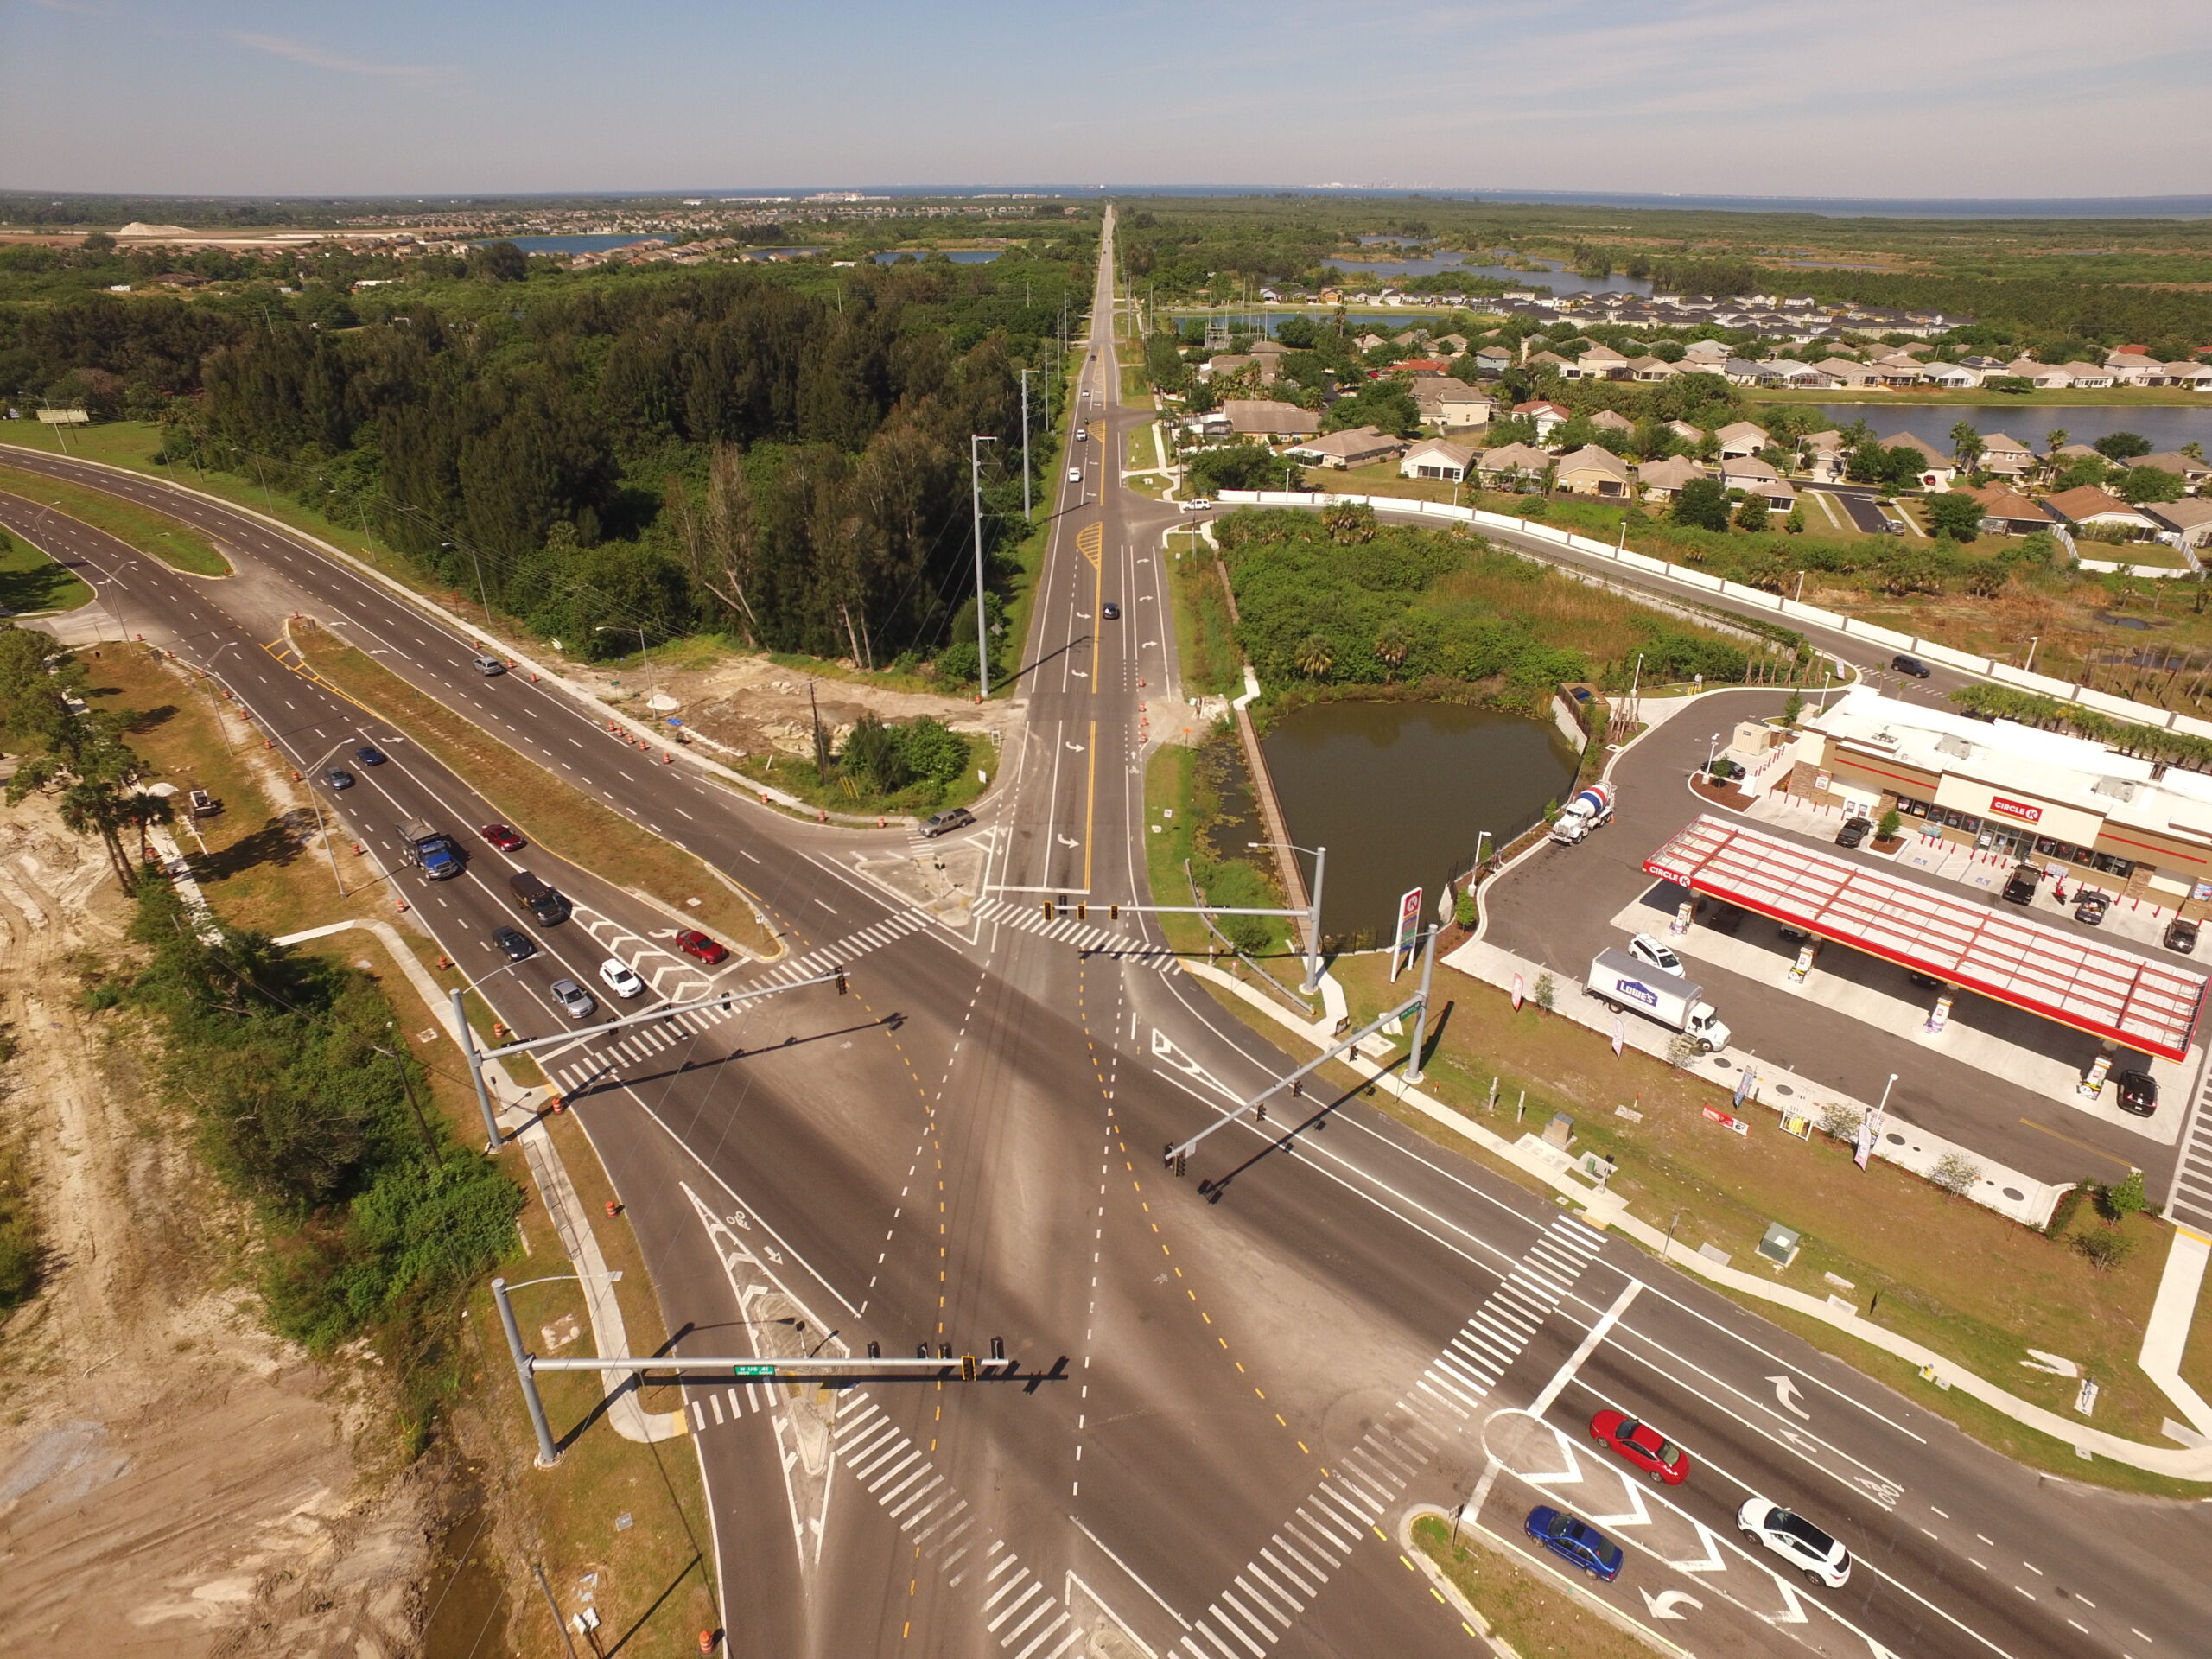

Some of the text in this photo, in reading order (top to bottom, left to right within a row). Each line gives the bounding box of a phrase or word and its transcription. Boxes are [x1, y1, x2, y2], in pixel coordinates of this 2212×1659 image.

[1994, 802, 2037, 819] CIRCLE K
[1649, 866, 1690, 887] CIRCLE K
[1619, 982, 1655, 1003] LOWE'S
